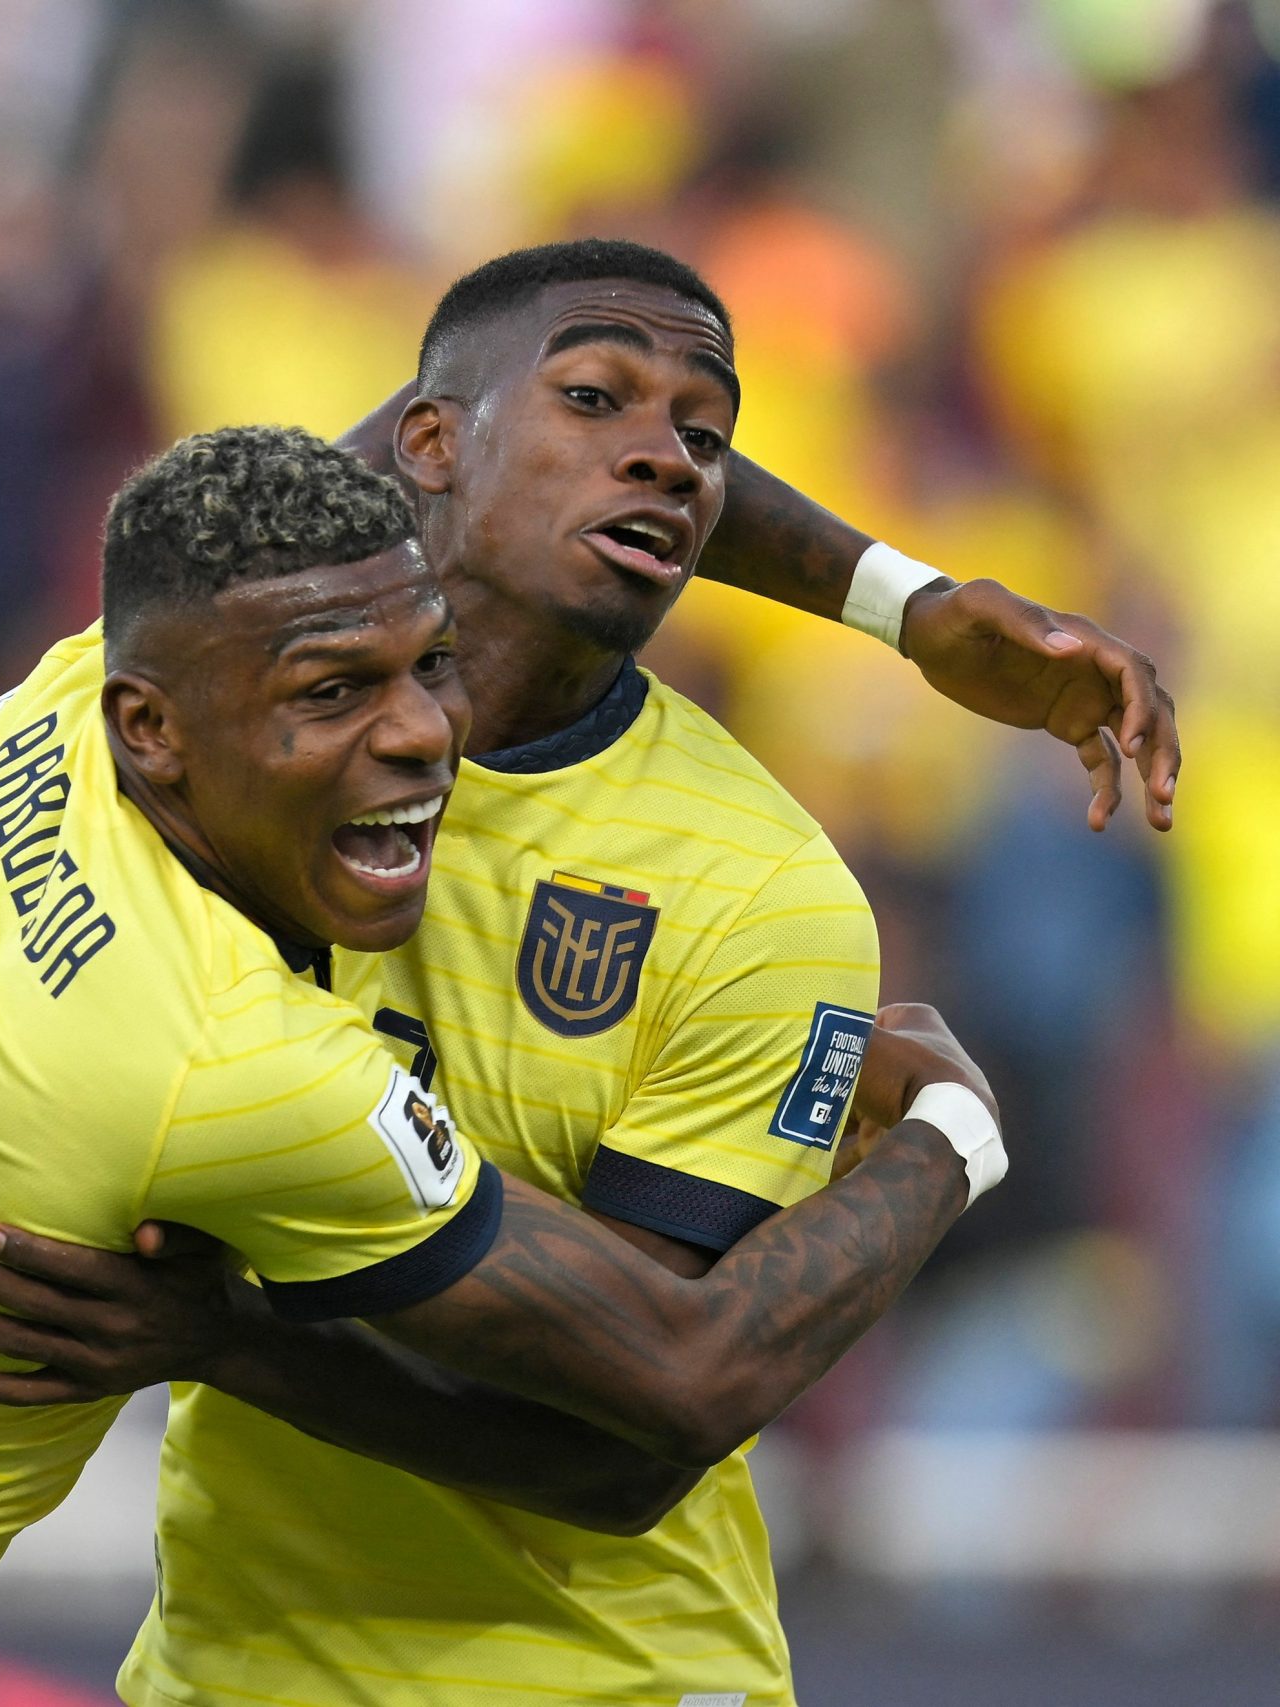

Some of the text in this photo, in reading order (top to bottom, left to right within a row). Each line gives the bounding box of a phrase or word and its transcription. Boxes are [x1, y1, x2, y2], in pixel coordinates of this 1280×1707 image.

[829, 1030, 866, 1055] FOOTBALL
[822, 1048, 861, 1079] UNITES
[811, 1074, 831, 1094] the
